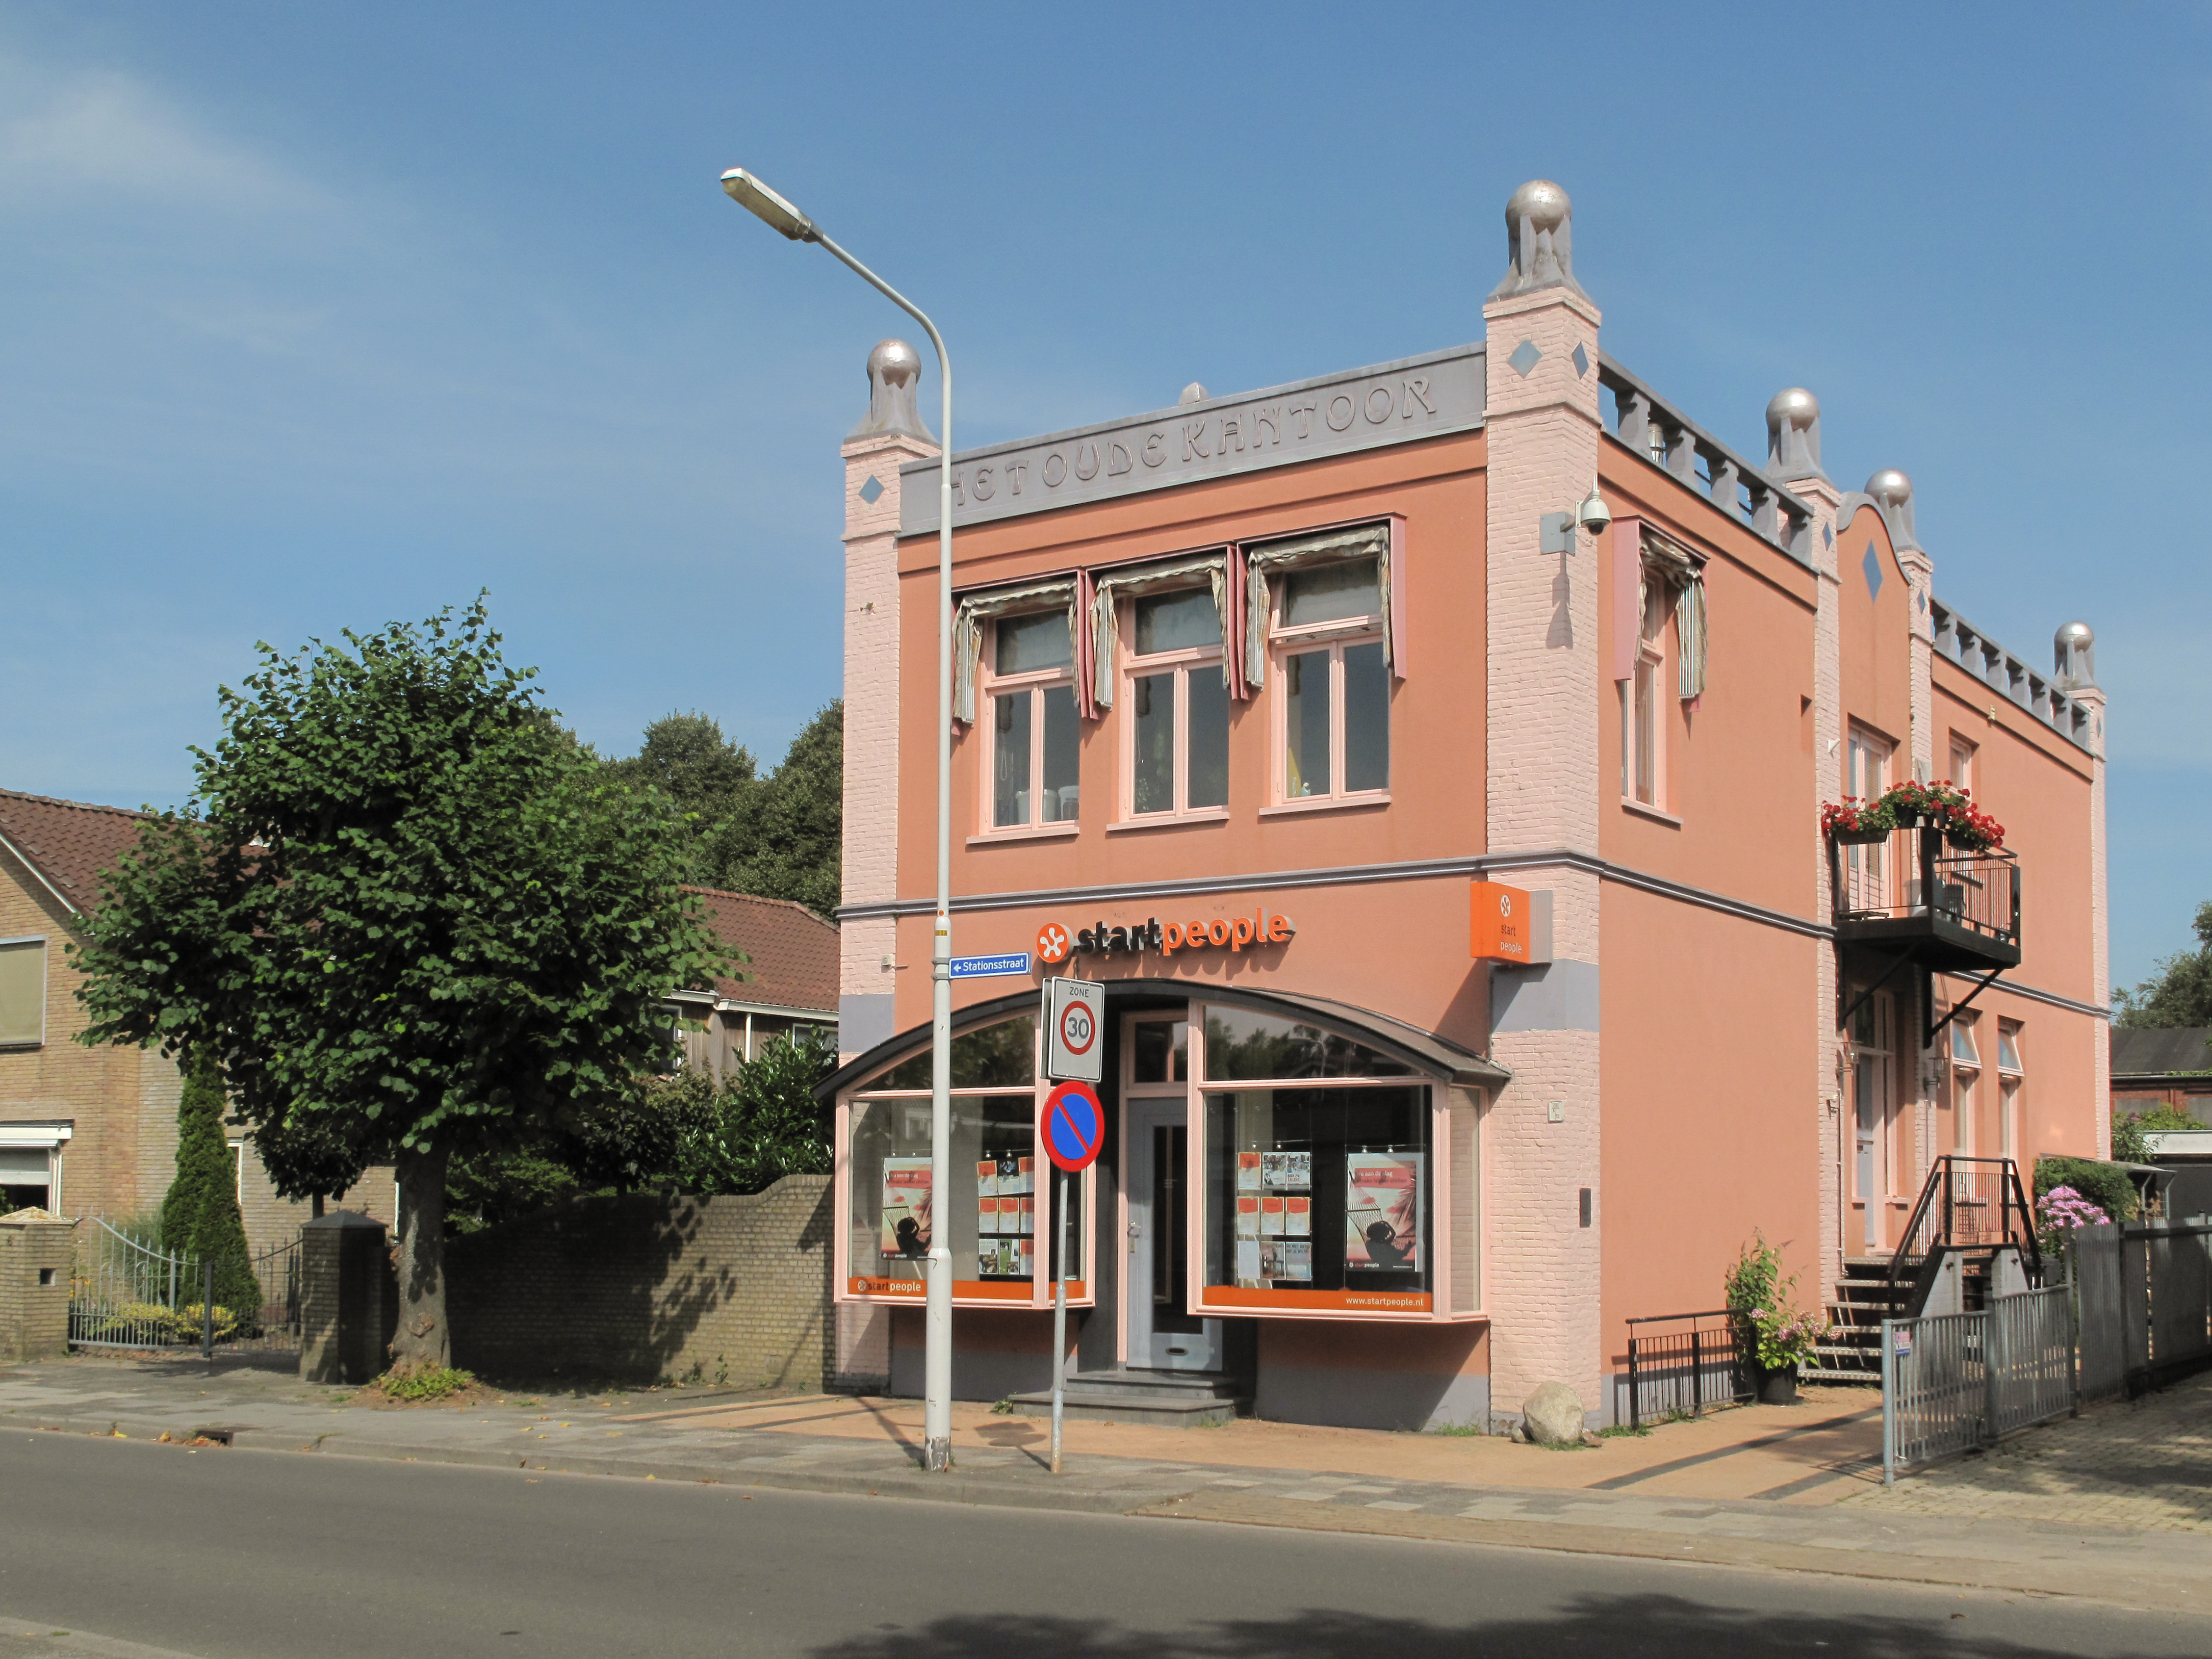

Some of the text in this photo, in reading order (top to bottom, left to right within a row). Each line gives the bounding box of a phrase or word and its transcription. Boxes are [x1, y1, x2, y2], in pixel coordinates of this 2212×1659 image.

[951, 375, 1436, 506] HET OUDE KANTOOR
[1077, 908, 1290, 956] startpeople
[1501, 923, 1516, 937] start
[1500, 941, 1522, 954] people
[963, 958, 1024, 972] Stationsstraat
[1069, 987, 1089, 998] ZONE
[1067, 1017, 1089, 1039] 30
[868, 1282, 921, 1293] startpeople
[1346, 1298, 1423, 1307] www.startpeople.nl
